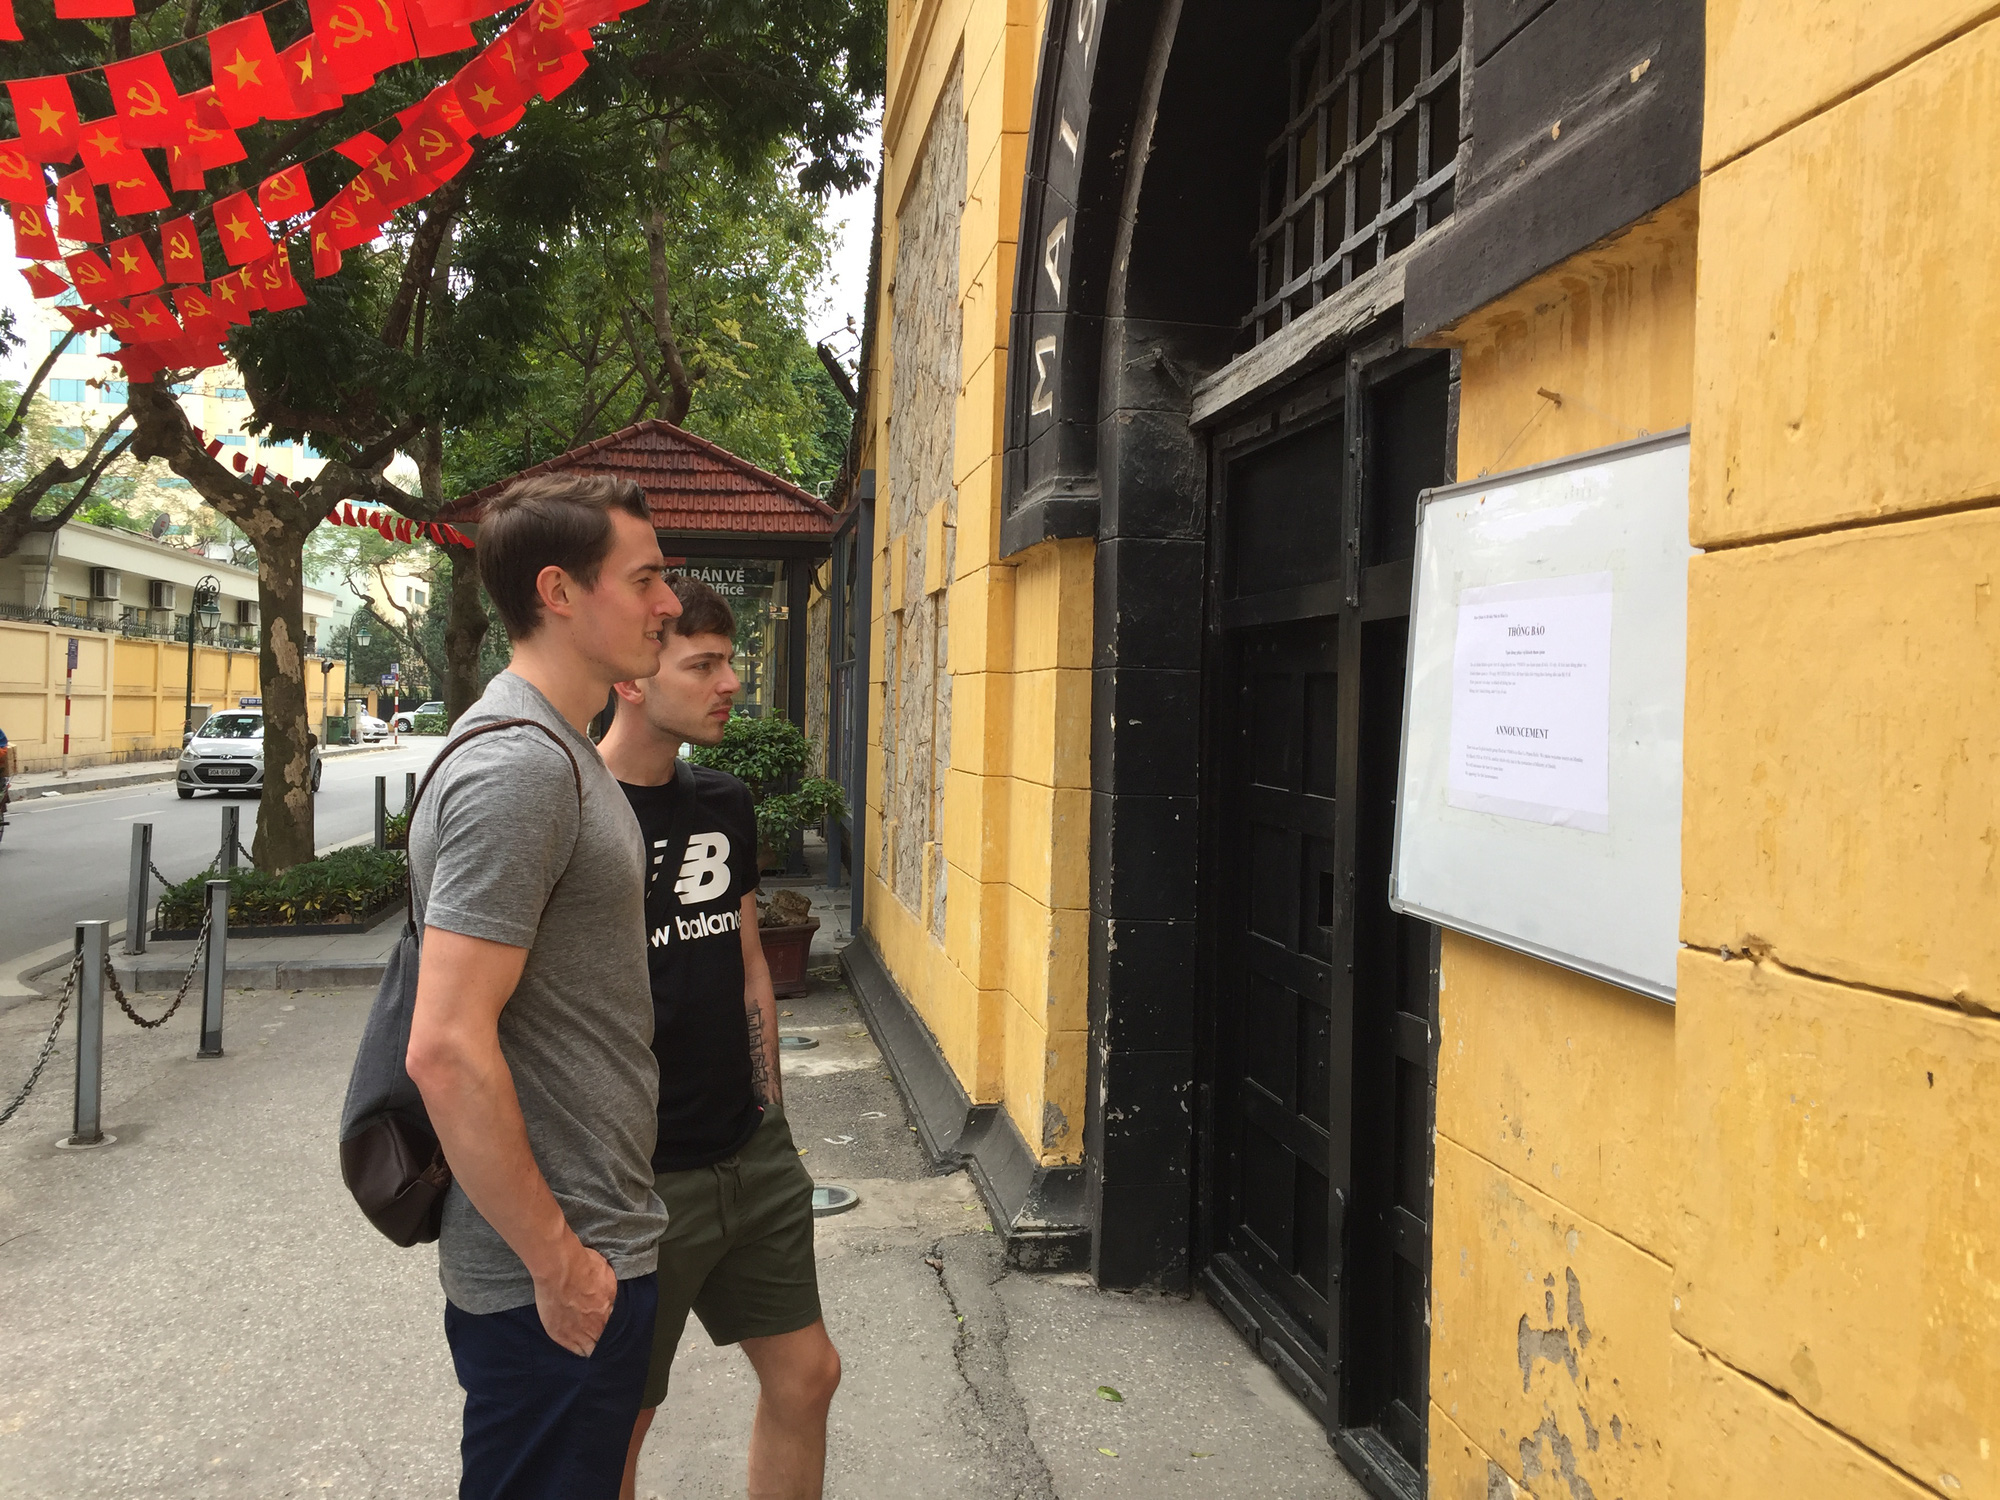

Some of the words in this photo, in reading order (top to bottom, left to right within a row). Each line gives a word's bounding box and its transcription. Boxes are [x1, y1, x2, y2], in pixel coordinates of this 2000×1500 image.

[691, 566, 722, 582] BÁN
[725, 567, 745, 583] VÉ
[1508, 623, 1530, 637] THÔNG
[1495, 725, 1549, 739] ANNOUNCEMENT
